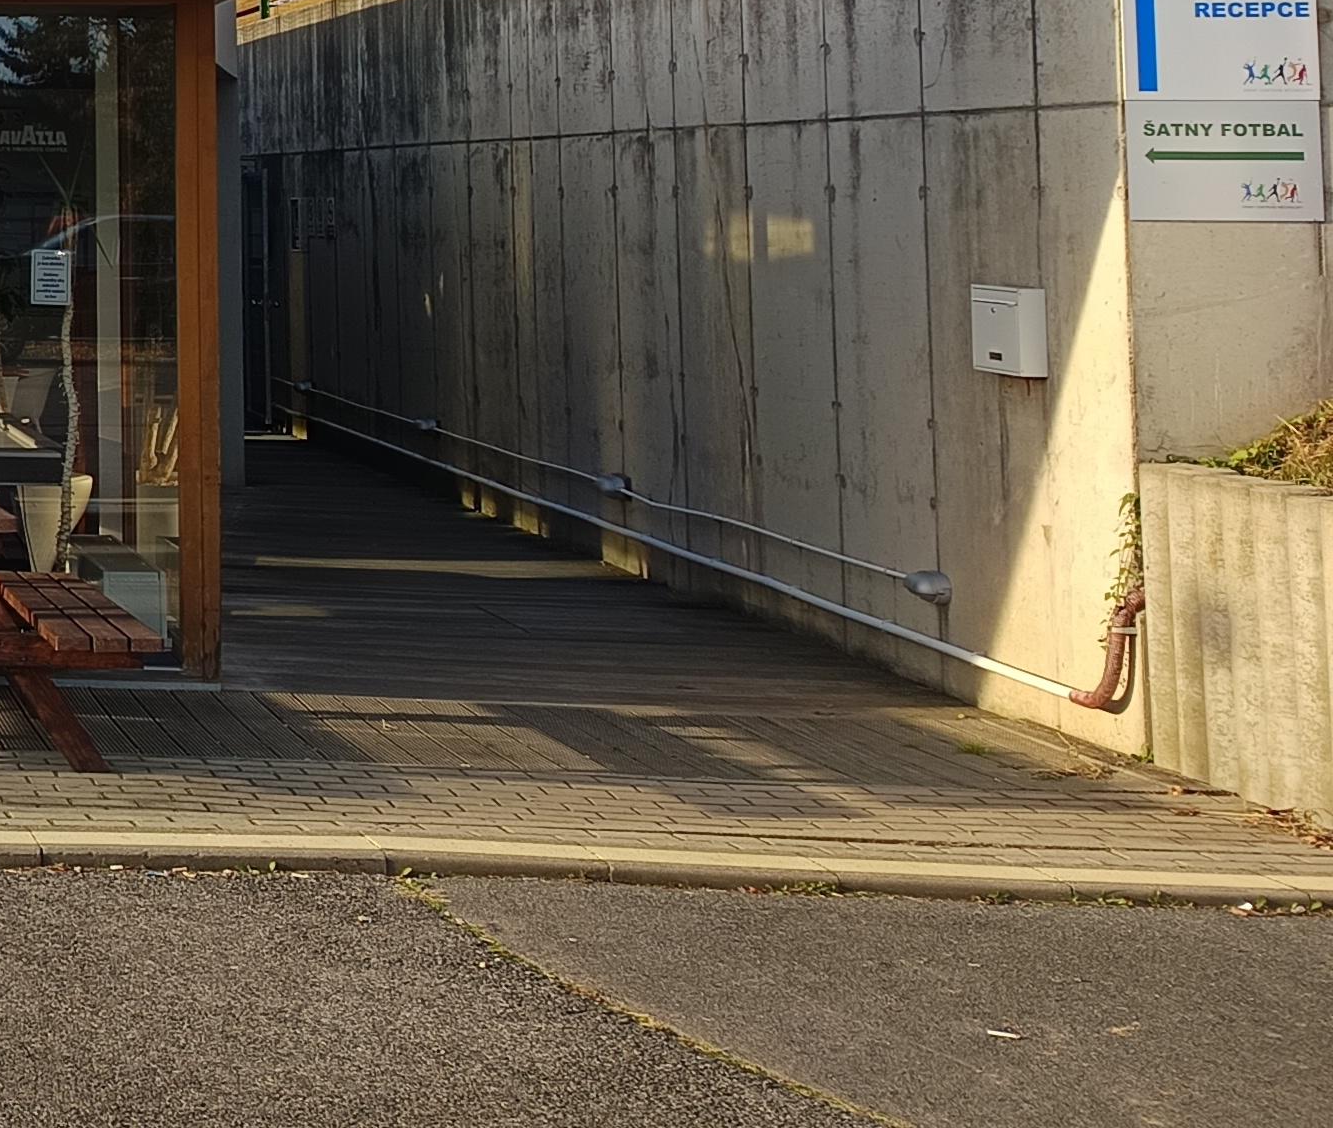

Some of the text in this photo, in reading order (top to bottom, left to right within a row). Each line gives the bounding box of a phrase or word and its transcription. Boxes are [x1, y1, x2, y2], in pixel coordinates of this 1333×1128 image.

[1194, 1, 1310, 19] RECEPCE
[1143, 119, 1304, 137] ŠATNY FOTBAL
